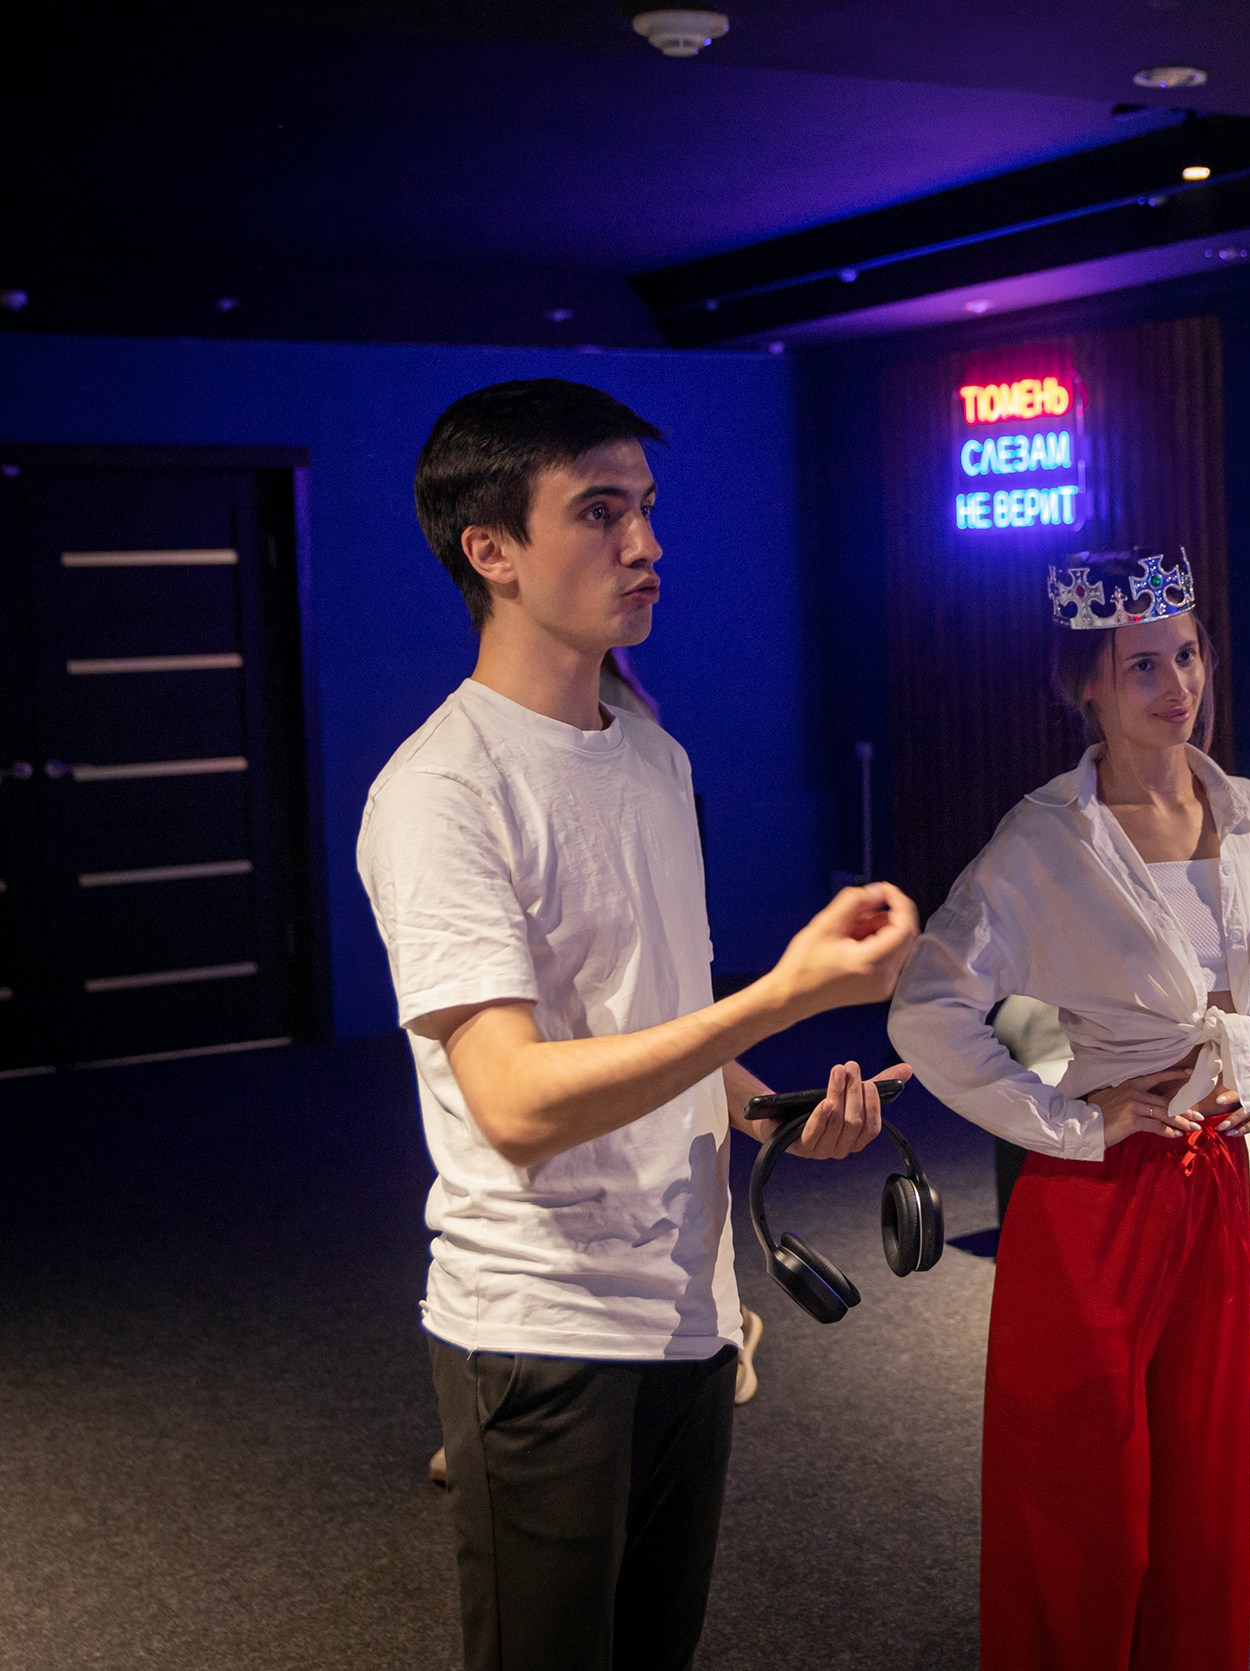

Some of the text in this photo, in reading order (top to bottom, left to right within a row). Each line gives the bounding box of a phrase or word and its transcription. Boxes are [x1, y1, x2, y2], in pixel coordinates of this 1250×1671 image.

[959, 376, 1070, 424] ТЮМЕНЬ
[960, 430, 1071, 476] СЛЕЗАМ
[955, 484, 1079, 529] НЕ ВЕРИТ
